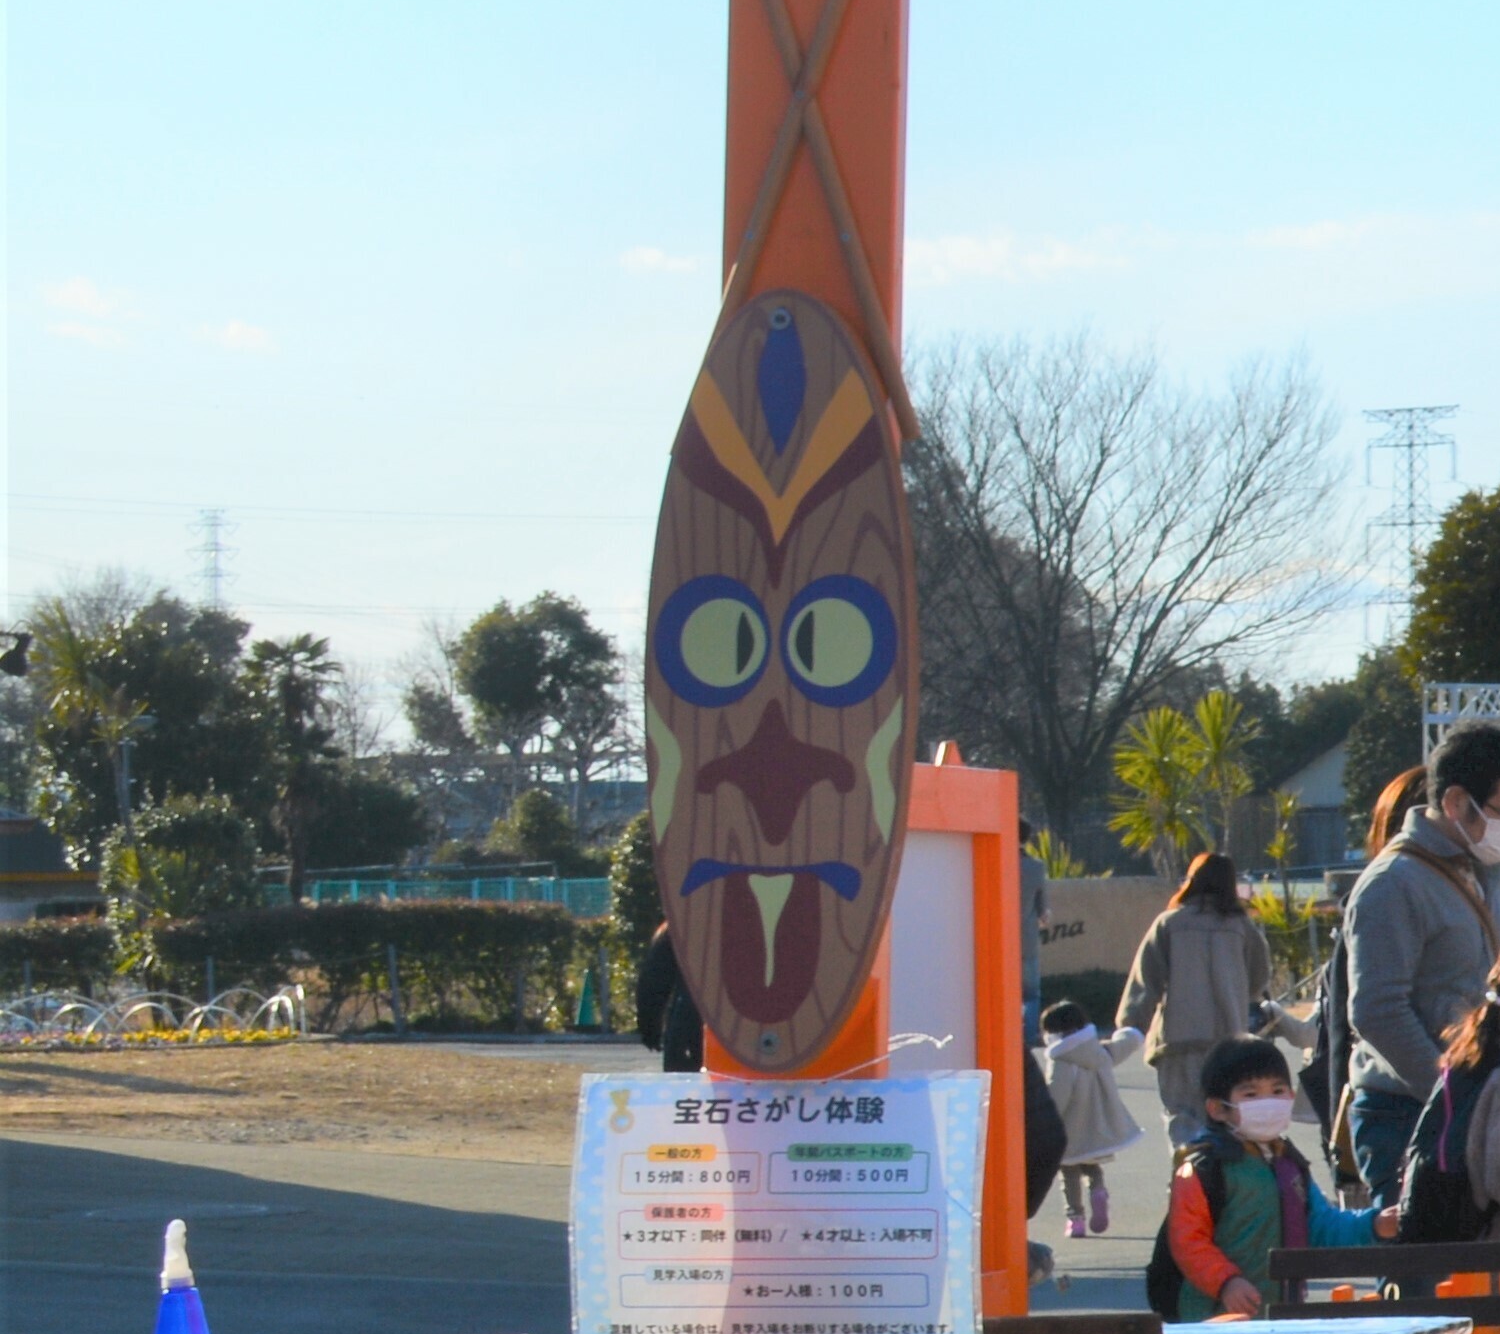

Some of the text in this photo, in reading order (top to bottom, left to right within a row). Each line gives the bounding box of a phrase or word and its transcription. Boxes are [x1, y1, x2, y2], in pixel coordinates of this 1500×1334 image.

[673, 1096, 885, 1124] 宝石さがし体験
[654, 1148, 703, 1160] 一般の方
[651, 1207, 713, 1219] 保護者の方
[652, 1269, 724, 1281] 見学入場の方
